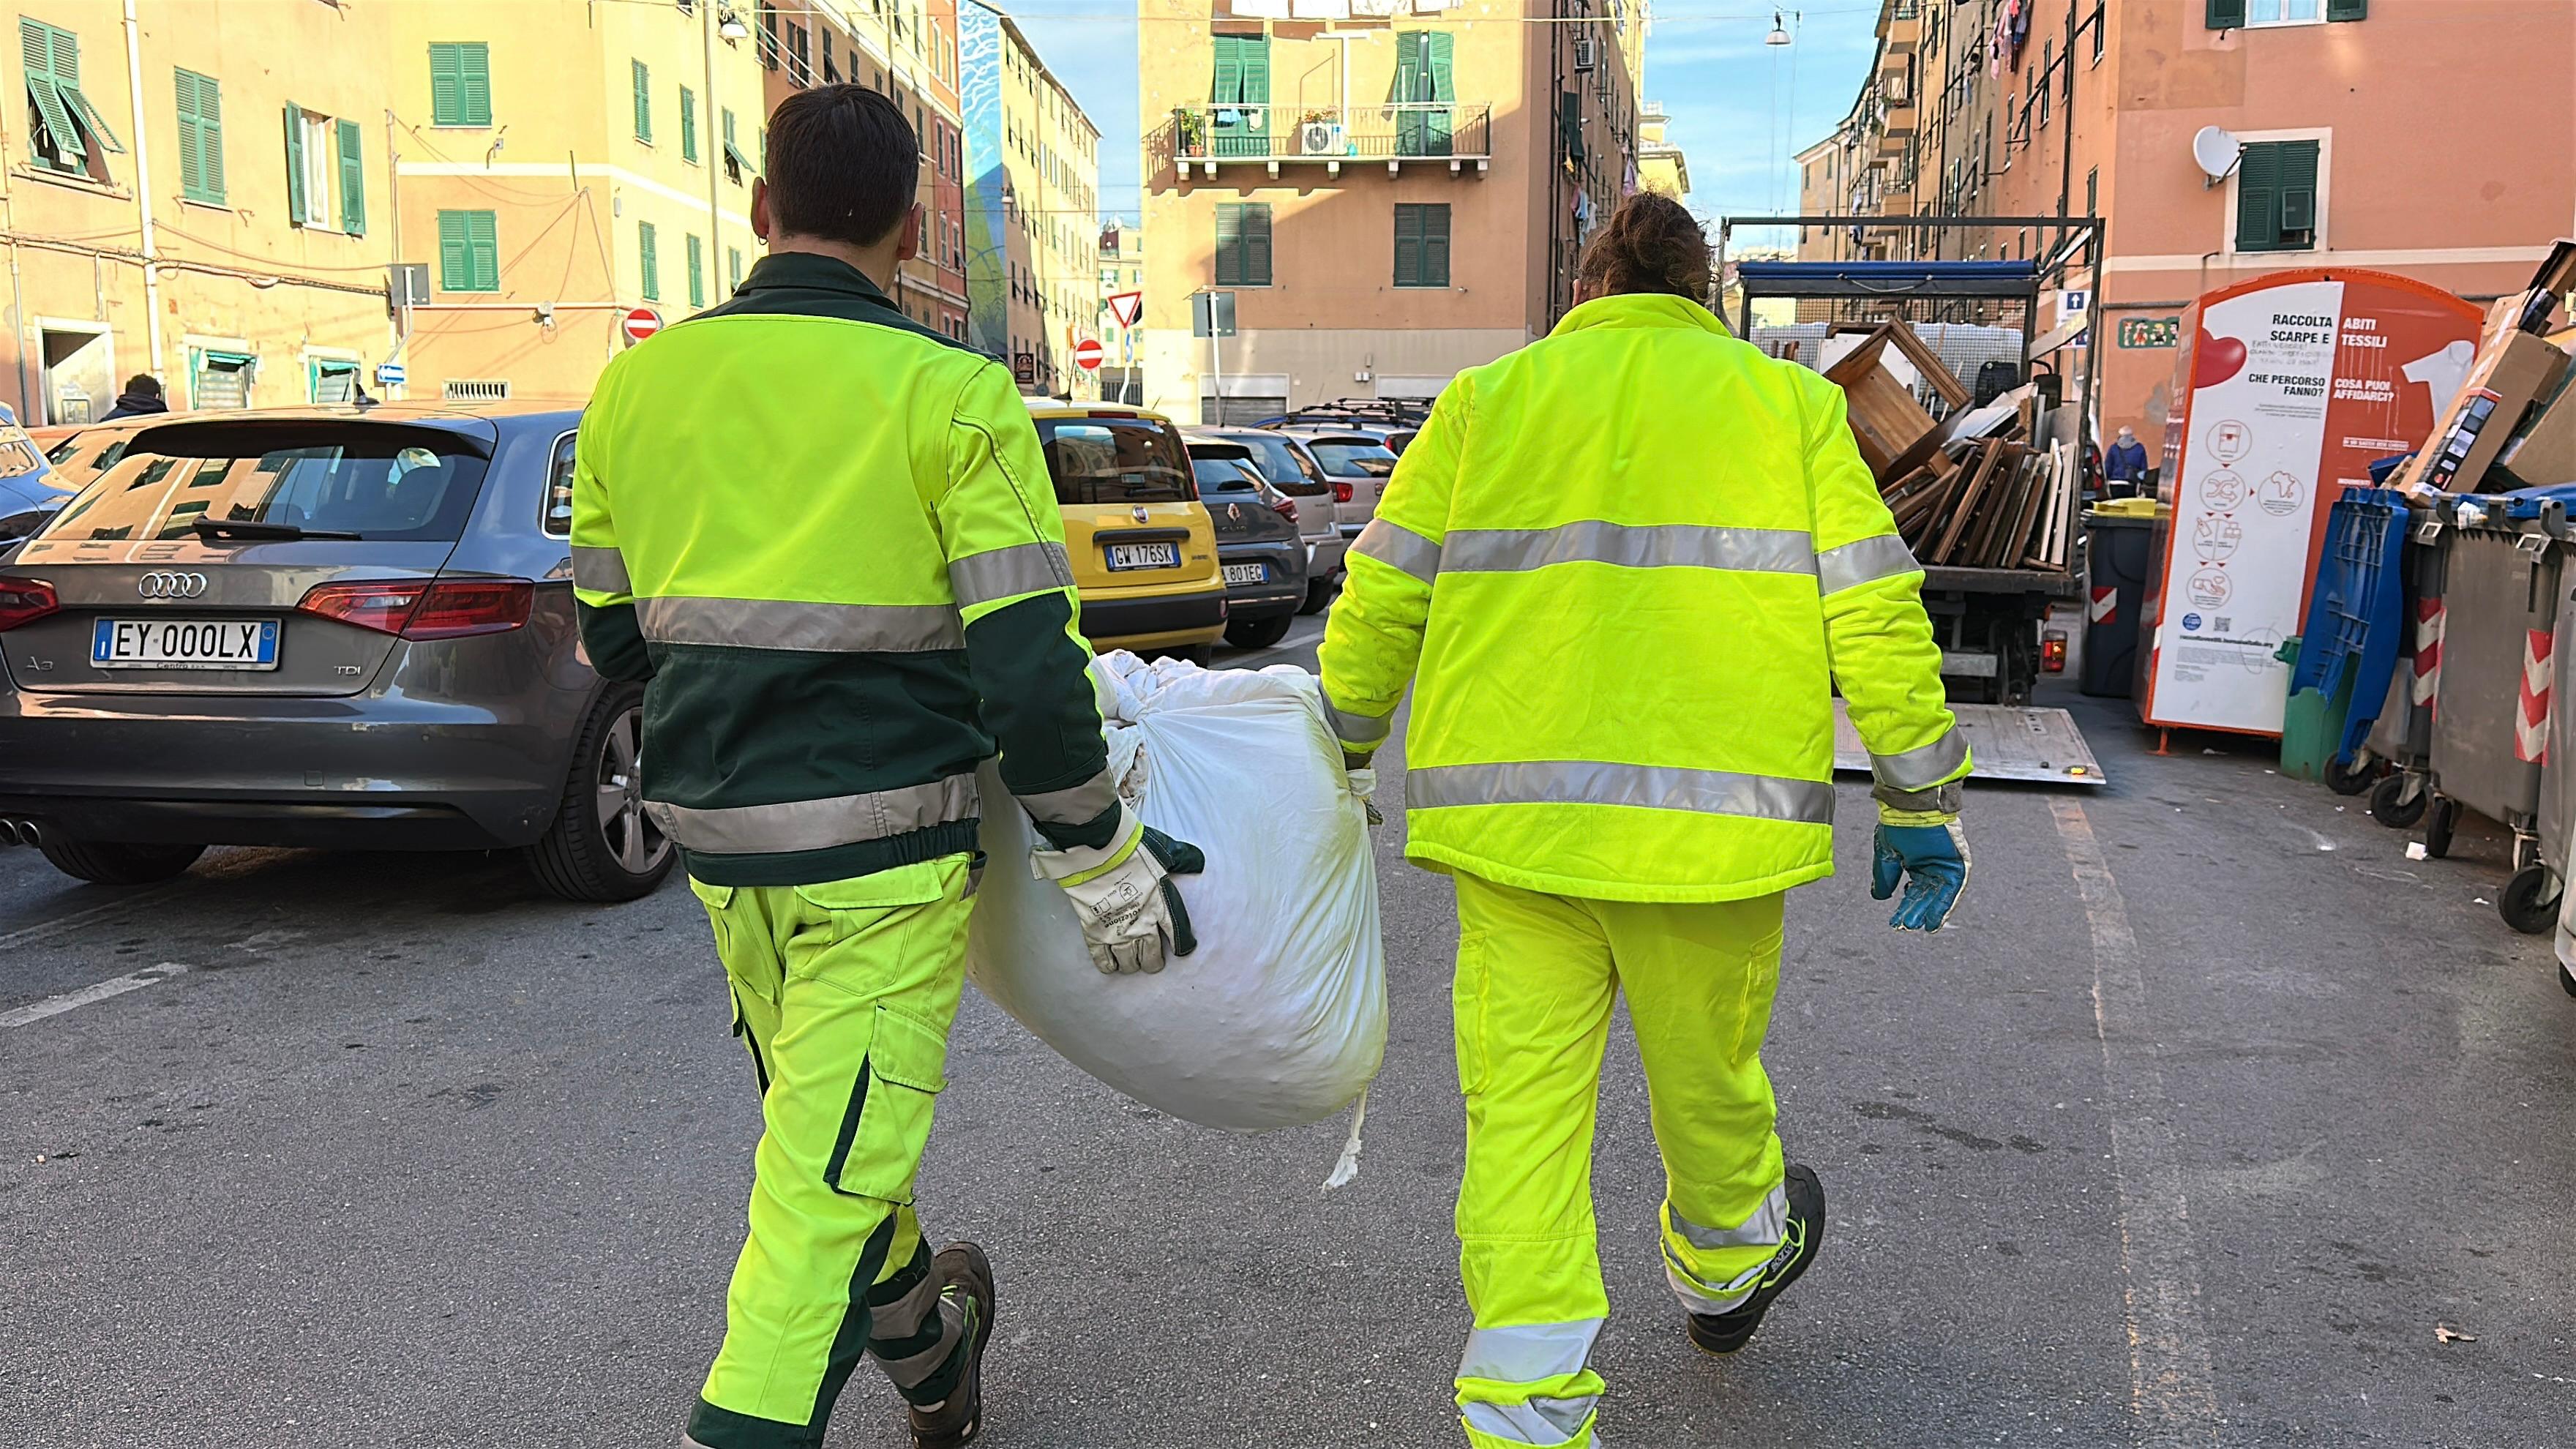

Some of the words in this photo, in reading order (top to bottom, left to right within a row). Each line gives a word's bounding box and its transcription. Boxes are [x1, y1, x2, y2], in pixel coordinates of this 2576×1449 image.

[2272, 314, 2332, 327] RACCOLTA
[2343, 318, 2377, 331] ABITI
[2270, 331, 2318, 343] SCARPE
[2323, 334, 2330, 344] E
[2341, 334, 2387, 348] TESSILI
[2249, 373, 2269, 383] CHE
[2272, 375, 2325, 386] PERCORSO
[2334, 378, 2362, 389] COSA
[2365, 380, 2391, 391] PUOI
[2283, 386, 2324, 397] FANNO?
[2333, 389, 2395, 402] AFFIDARCI?
[1136, 544, 1172, 563] 176SK
[1229, 565, 1262, 581] 801EG
[116, 624, 153, 656] EY
[162, 624, 258, 658] 000LX
[26, 656, 53, 670] A3
[334, 666, 361, 675] TDI
